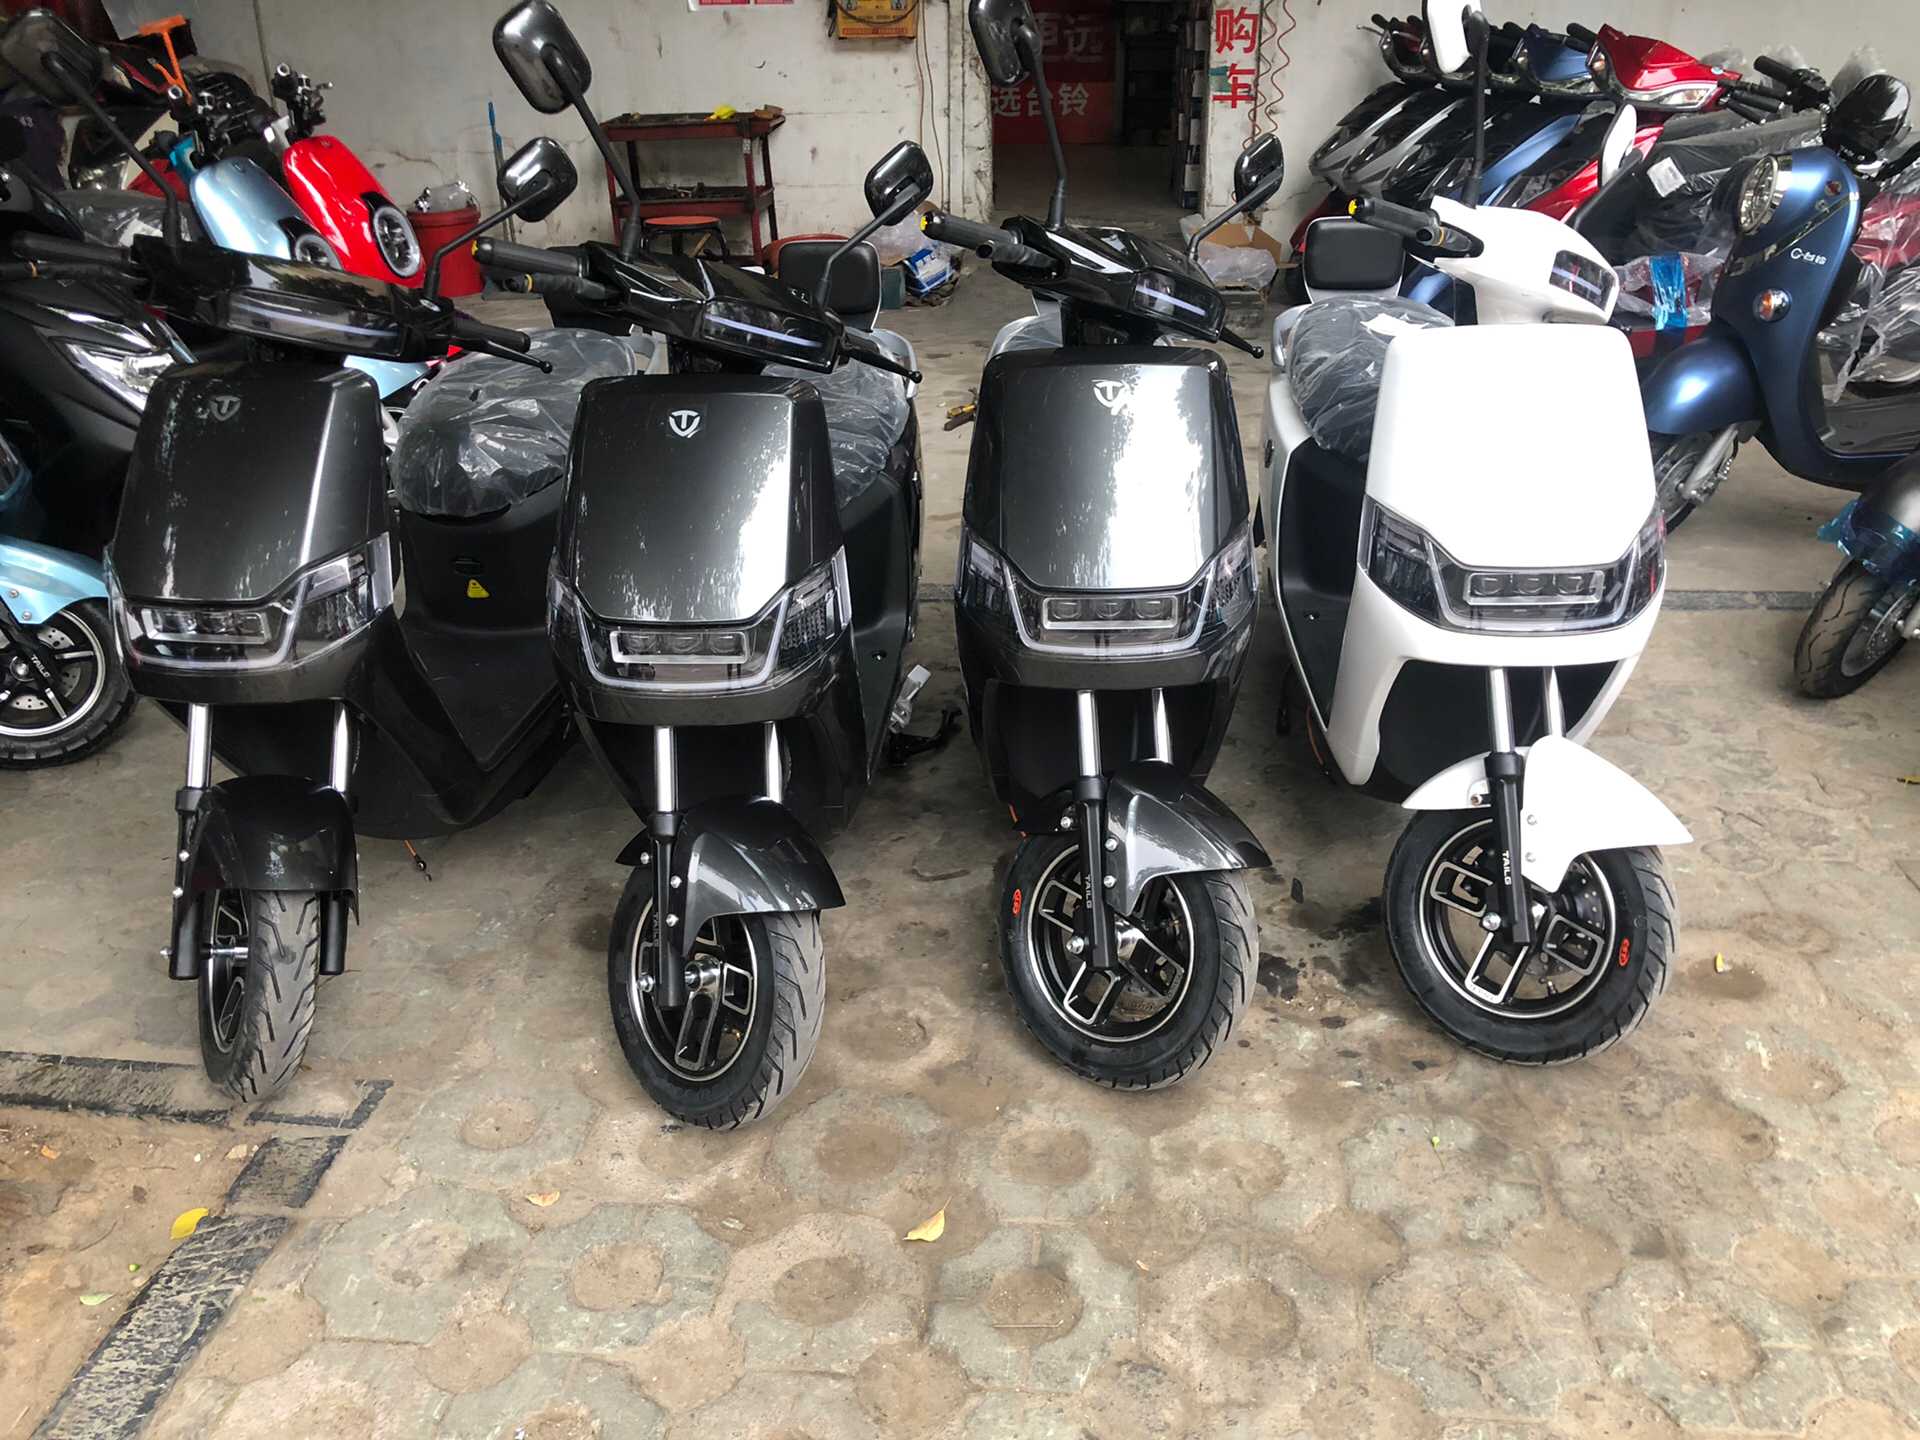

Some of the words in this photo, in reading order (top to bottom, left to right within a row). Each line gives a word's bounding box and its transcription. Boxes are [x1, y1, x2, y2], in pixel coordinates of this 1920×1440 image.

[1212, 6, 1258, 109] 购车
[1502, 850, 1512, 886] TAILG
[1084, 874, 1092, 909] TAILG
